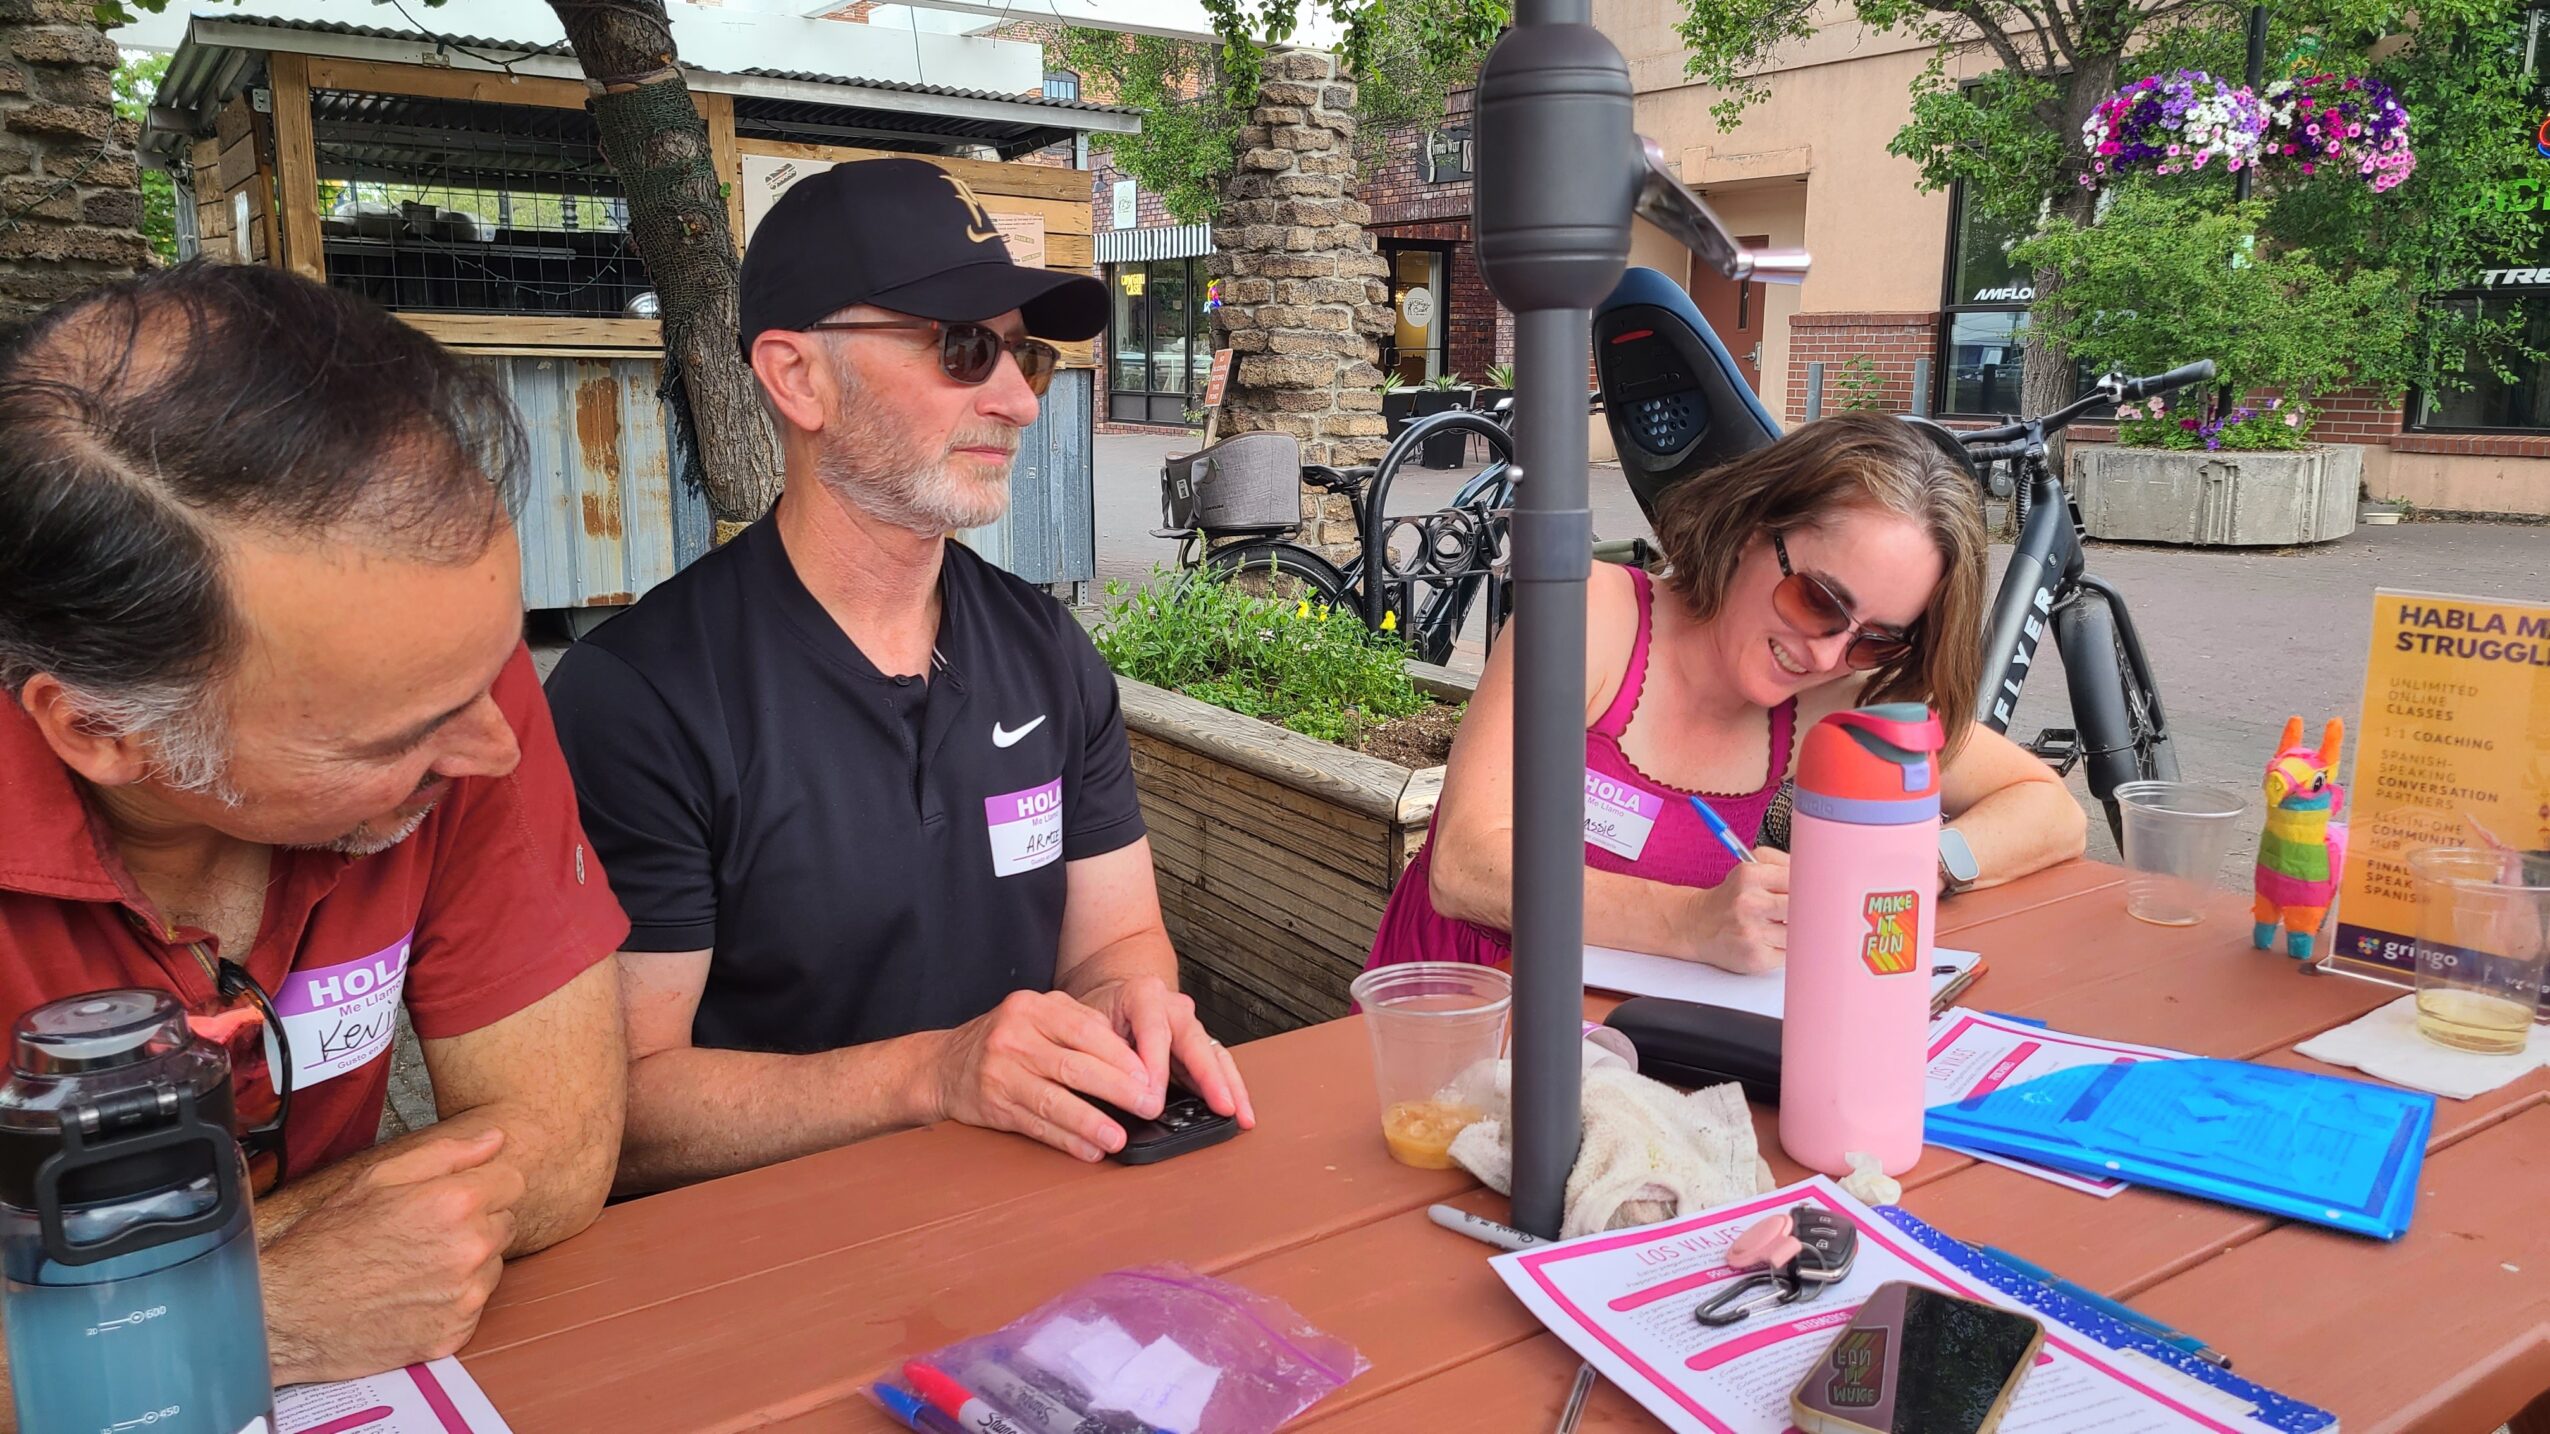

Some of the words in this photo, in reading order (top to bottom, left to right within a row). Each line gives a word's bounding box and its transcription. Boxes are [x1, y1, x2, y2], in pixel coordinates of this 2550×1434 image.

[1973, 287, 2036, 301] AMFLO
[2399, 604, 2507, 636] HABLA
[2516, 615, 2550, 640] M
[1993, 586, 2055, 727] FLYER
[2390, 677, 2479, 698] UNLIMITED
[2388, 690, 2447, 708] ONLINE
[2386, 703, 2454, 722] CLASSES
[2413, 730, 2495, 752] COACHING
[2381, 748, 2454, 768] SPANISH-
[2380, 762, 2457, 784] SPEAKING
[1585, 774, 1640, 813] HOLA
[2376, 788, 2454, 810] PARTNERS
[2377, 775, 2499, 804] CONVERSATION
[1017, 784, 1062, 818] HOLA
[1588, 797, 1599, 807] Me
[1600, 801, 1625, 818] Llamo
[1584, 818, 1617, 838] assie
[2371, 824, 2467, 848] COMMUNITY
[2369, 837, 2402, 851] HUB
[2366, 871, 2413, 890] SPEAK
[1867, 893, 1913, 916] MAKE
[1877, 914, 1897, 935] IT
[1866, 932, 1904, 958] FUN
[2382, 940, 2459, 971] gringo
[308, 943, 411, 1008] HOLA
[339, 1002, 362, 1018] Me
[365, 980, 402, 1008] Llamo
[337, 1053, 368, 1070] Gusto
[368, 1045, 379, 1056] en
[1635, 1245, 1681, 1267] LOS
[145, 1305, 168, 1320] 600
[86, 1327, 98, 1336] 20
[159, 1404, 181, 1418] 450
